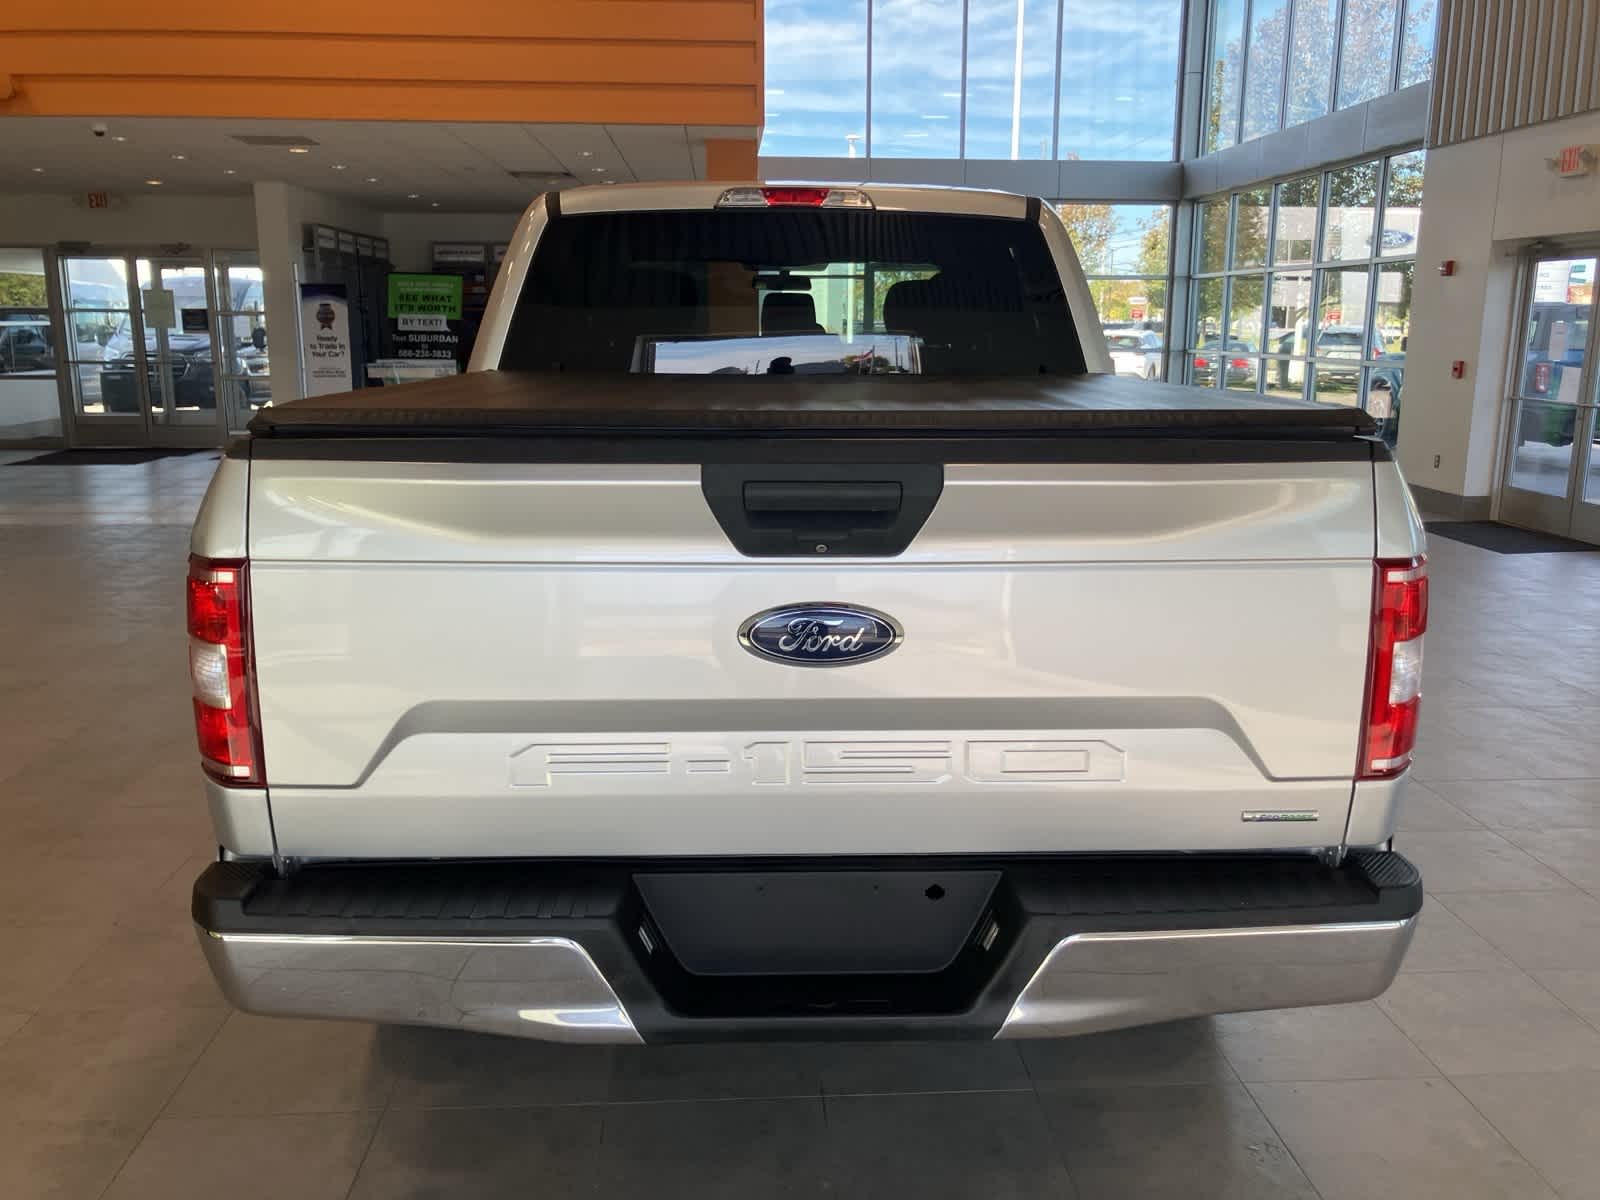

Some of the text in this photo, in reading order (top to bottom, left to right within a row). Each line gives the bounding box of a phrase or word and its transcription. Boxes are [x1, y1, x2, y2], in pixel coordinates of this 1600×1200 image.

[88, 192, 108, 209] EXIT
[398, 293, 453, 303] SEE WHAT
[394, 304, 457, 313] IT'S WORTH
[401, 319, 443, 327] BY TEXT!
[316, 335, 338, 343] Ready
[408, 334, 459, 344] SUBURBAN
[328, 350, 345, 358] Car?
[777, 616, 865, 653] Ford
[509, 739, 1128, 788] F-150
